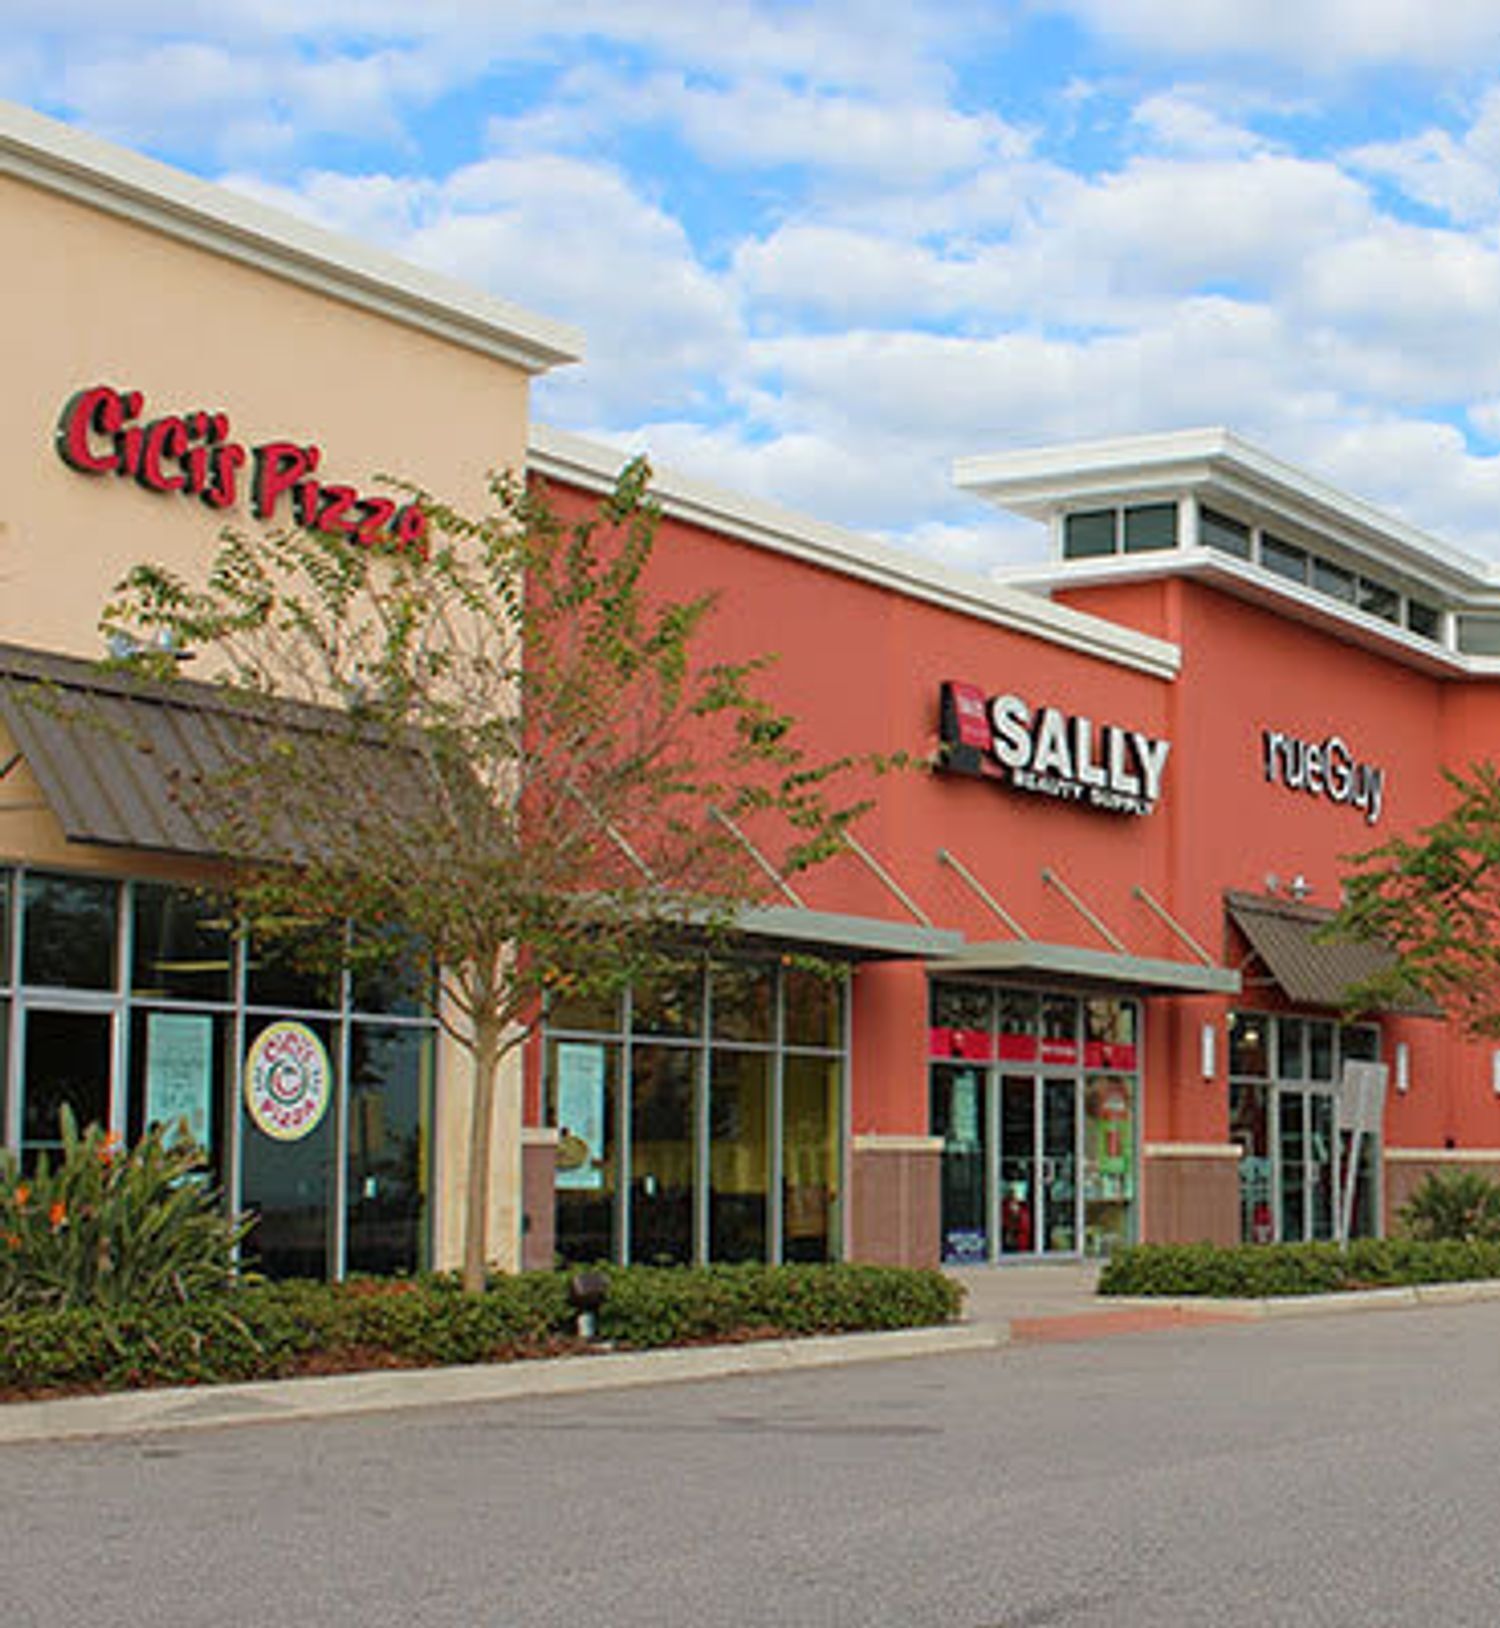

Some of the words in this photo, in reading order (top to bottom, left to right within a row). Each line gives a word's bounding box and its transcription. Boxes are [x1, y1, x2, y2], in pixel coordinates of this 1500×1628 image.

[57, 385, 246, 508] CiCi's
[252, 442, 430, 561] Pizza
[990, 693, 1171, 800] SALLY
[1012, 768, 1084, 800] BEAUTY
[1090, 787, 1153, 817] SUPPLY
[1263, 732, 1385, 825] rueGuy
